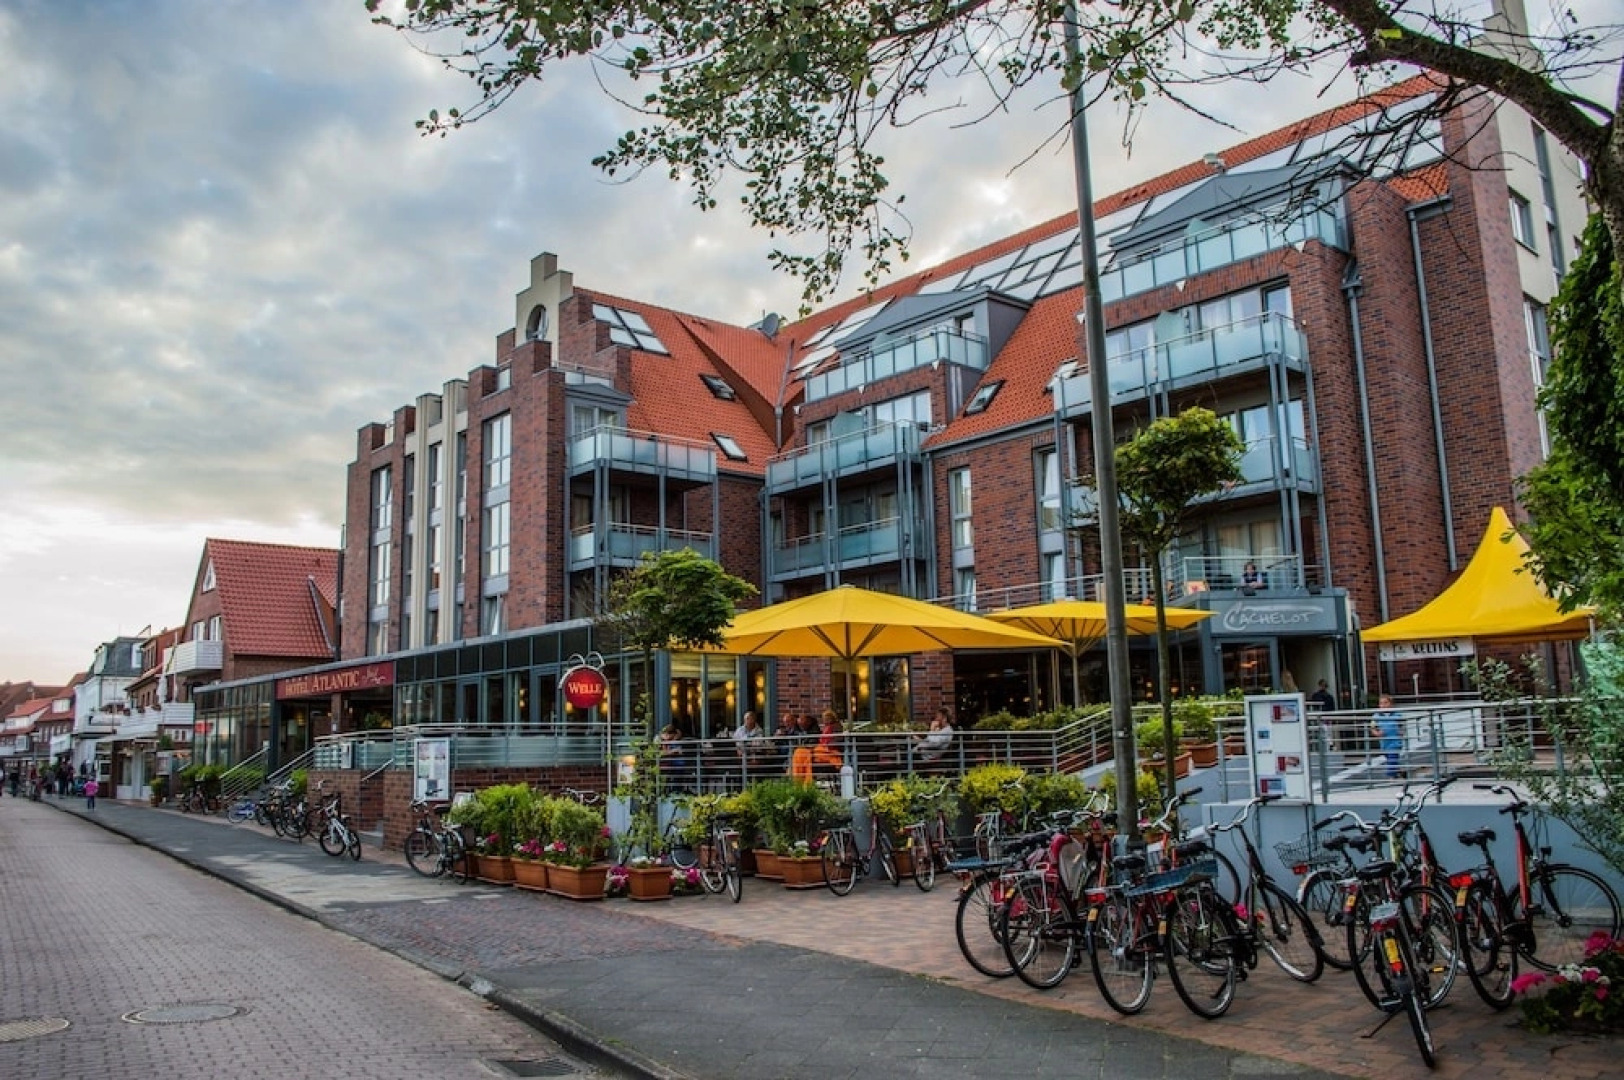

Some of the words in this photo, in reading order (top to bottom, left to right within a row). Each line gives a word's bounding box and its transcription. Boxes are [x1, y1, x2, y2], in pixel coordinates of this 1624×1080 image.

[1223, 602, 1324, 631] CACHELOT
[1411, 641, 1459, 654] VELTINS
[285, 681, 308, 696] HOTEL
[311, 670, 360, 692] ATLANTIC
[568, 682, 602, 694] WELLE
